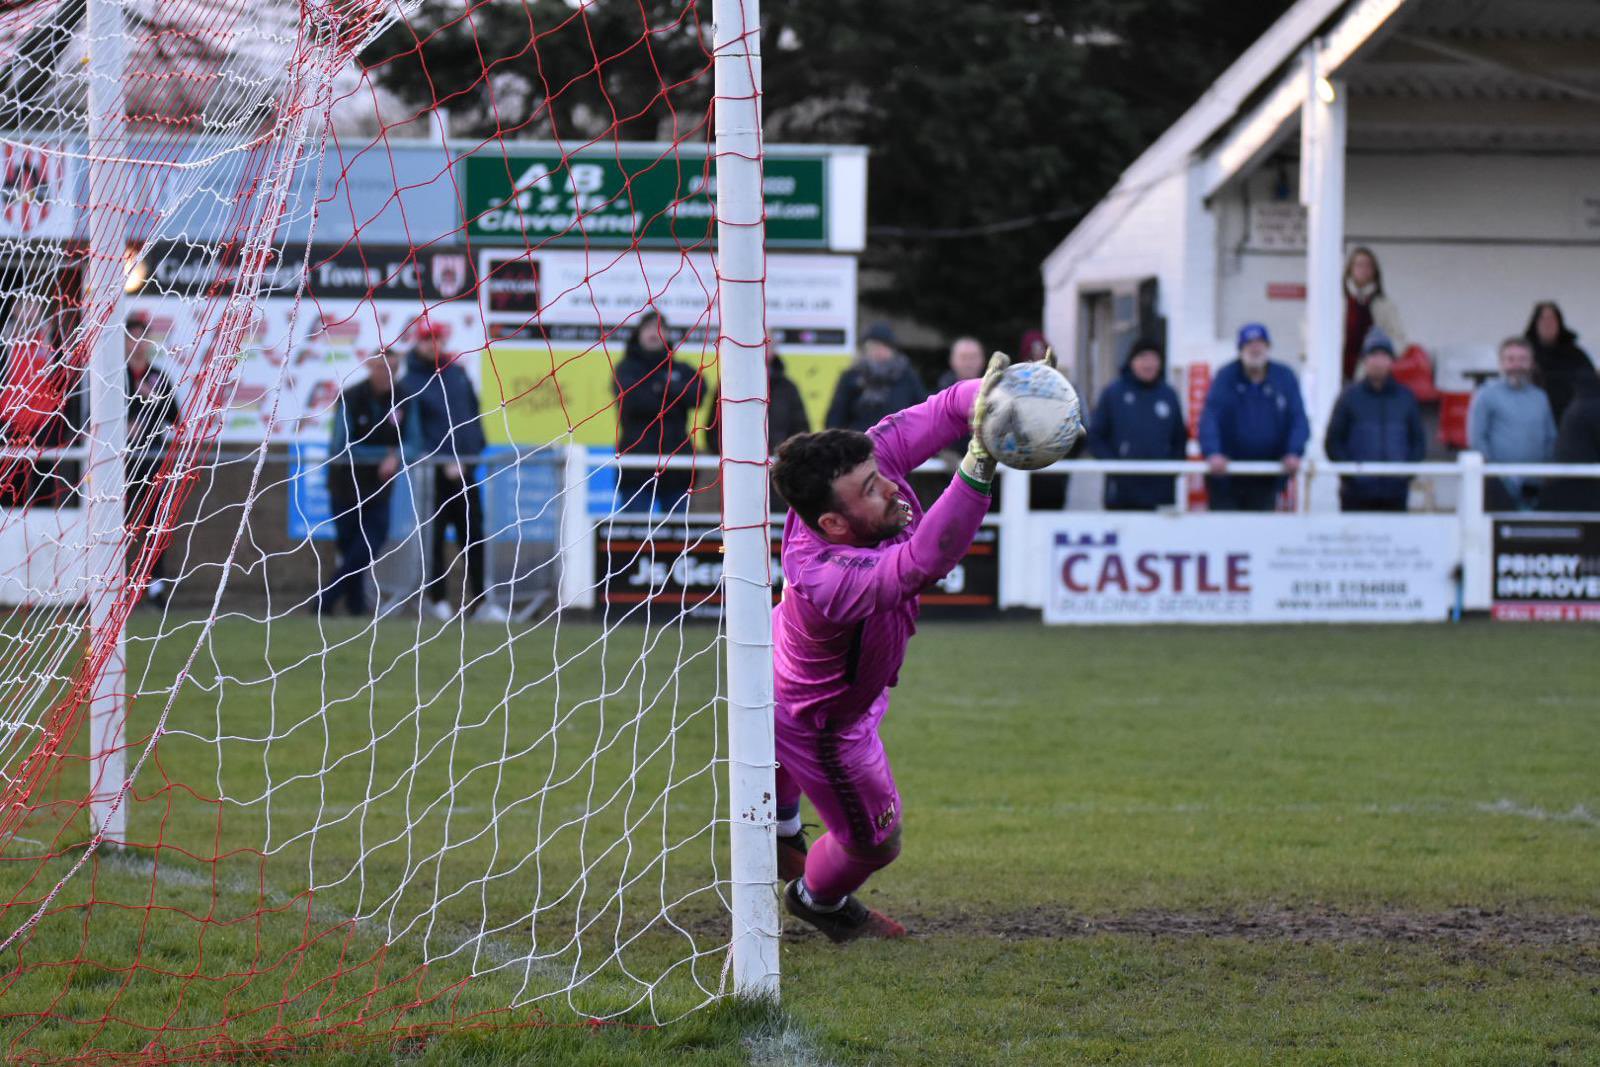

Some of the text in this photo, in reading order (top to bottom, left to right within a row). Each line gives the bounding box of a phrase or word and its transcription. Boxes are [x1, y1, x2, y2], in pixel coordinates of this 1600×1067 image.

[476, 209, 643, 233] Cleveland
[316, 260, 382, 288] Town
[386, 261, 426, 289] FC
[1060, 552, 1253, 594] CASTLE
[1497, 552, 1581, 577] PRIORY
